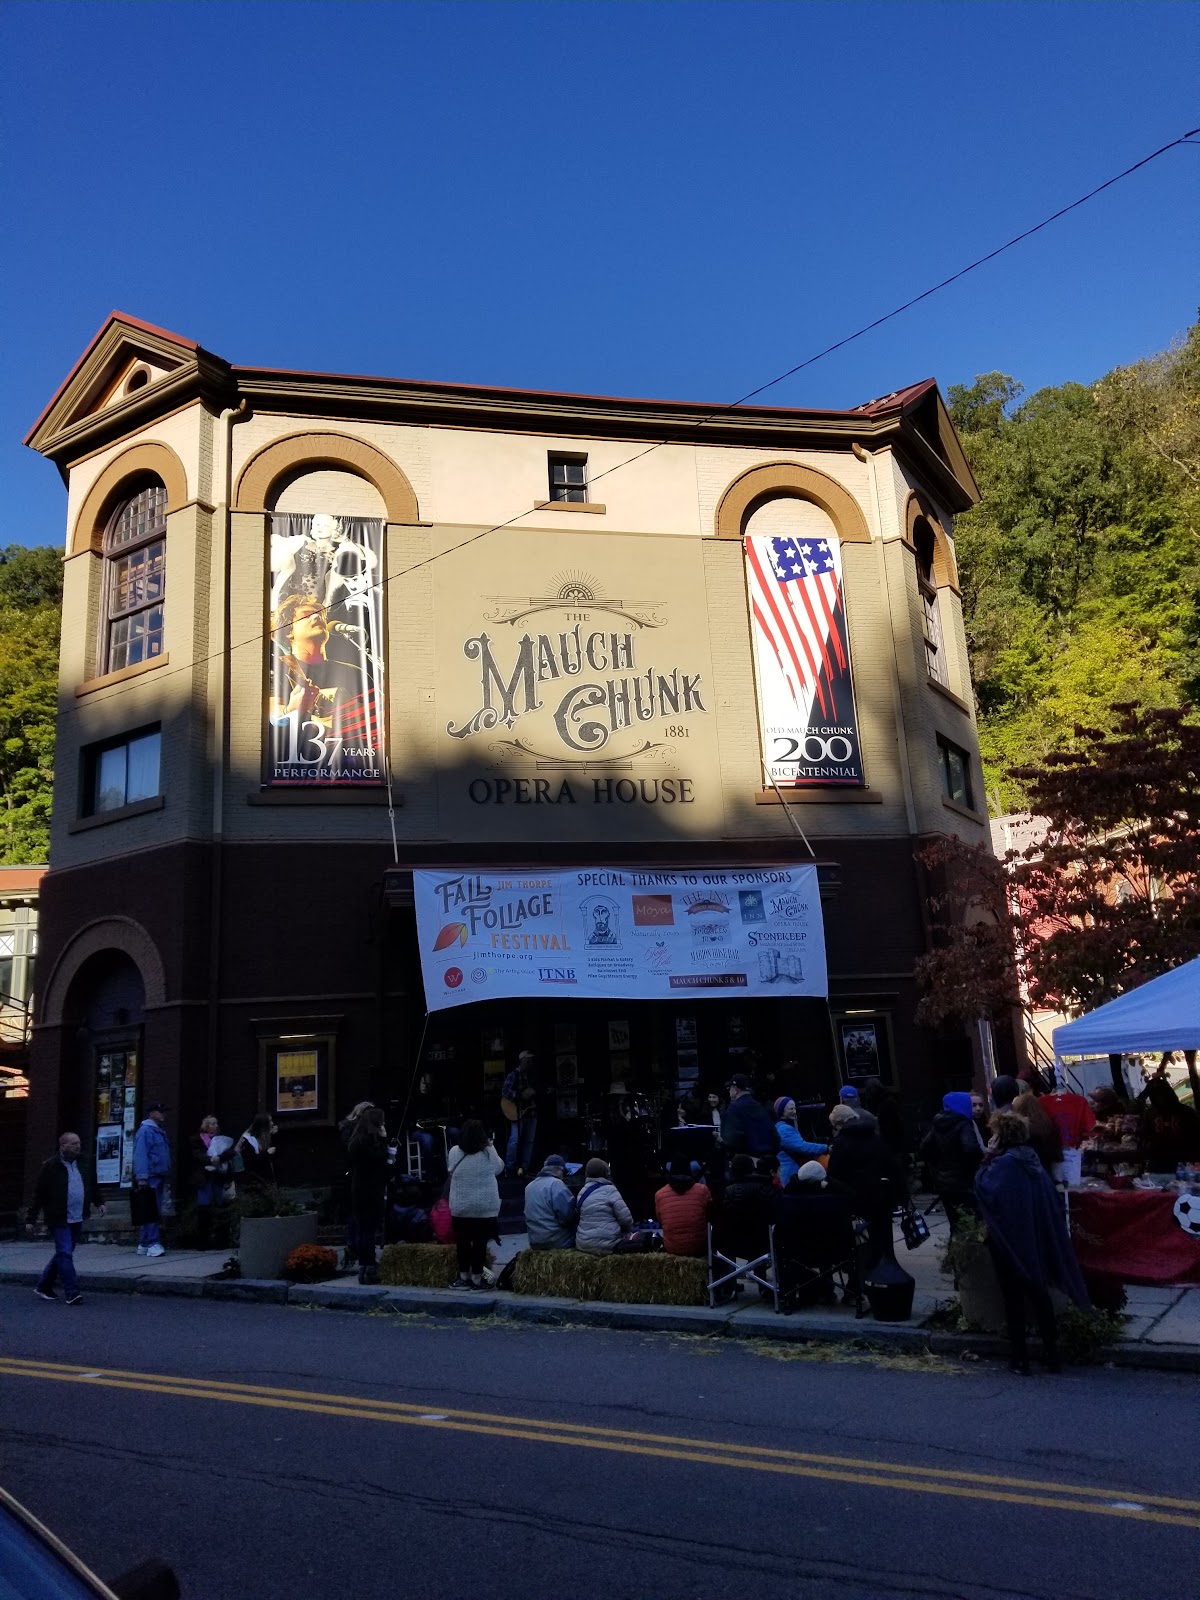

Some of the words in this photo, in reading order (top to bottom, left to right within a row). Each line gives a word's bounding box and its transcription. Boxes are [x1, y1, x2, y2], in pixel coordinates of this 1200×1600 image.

[563, 612, 591, 622] THE
[446, 623, 635, 739] MAUCH
[552, 667, 707, 752] CHUNK
[270, 709, 343, 766] 137
[664, 725, 690, 738] 1881
[766, 727, 785, 735] OLD
[787, 727, 819, 735] MAUCH
[820, 726, 854, 735] CHUNK
[342, 747, 376, 757] YEARS
[772, 736, 853, 762] 200
[273, 767, 380, 779] PERFORMANCE
[771, 766, 858, 777] BICENTENNIAL
[468, 778, 577, 805] OPERA
[591, 778, 696, 804] HOUSE
[497, 880, 513, 890] JIM
[516, 879, 553, 889] THORPE
[577, 873, 626, 886] SPECIAL
[630, 873, 678, 886] THANKS
[681, 875, 698, 886] TO
[702, 874, 728, 886] OUR
[732, 871, 792, 884] SPONSORS
[434, 875, 493, 914] FALL
[681, 890, 706, 906] THE
[708, 890, 733, 906] INN
[636, 904, 672, 917] Moya
[769, 896, 798, 916] MAUCH
[785, 903, 809, 918] CHUNK
[461, 893, 555, 936] FOLIAGE
[490, 932, 572, 951] FESTIVAL
[747, 931, 807, 947] STONEKEEP
[472, 952, 533, 960] jimthorpe.org
[537, 968, 576, 982] JTNB
[672, 976, 699, 985] MAUCH
[699, 976, 724, 985] CHUNK
[724, 976, 729, 984] 5
[729, 976, 736, 984] &
[736, 976, 745, 984] 10
